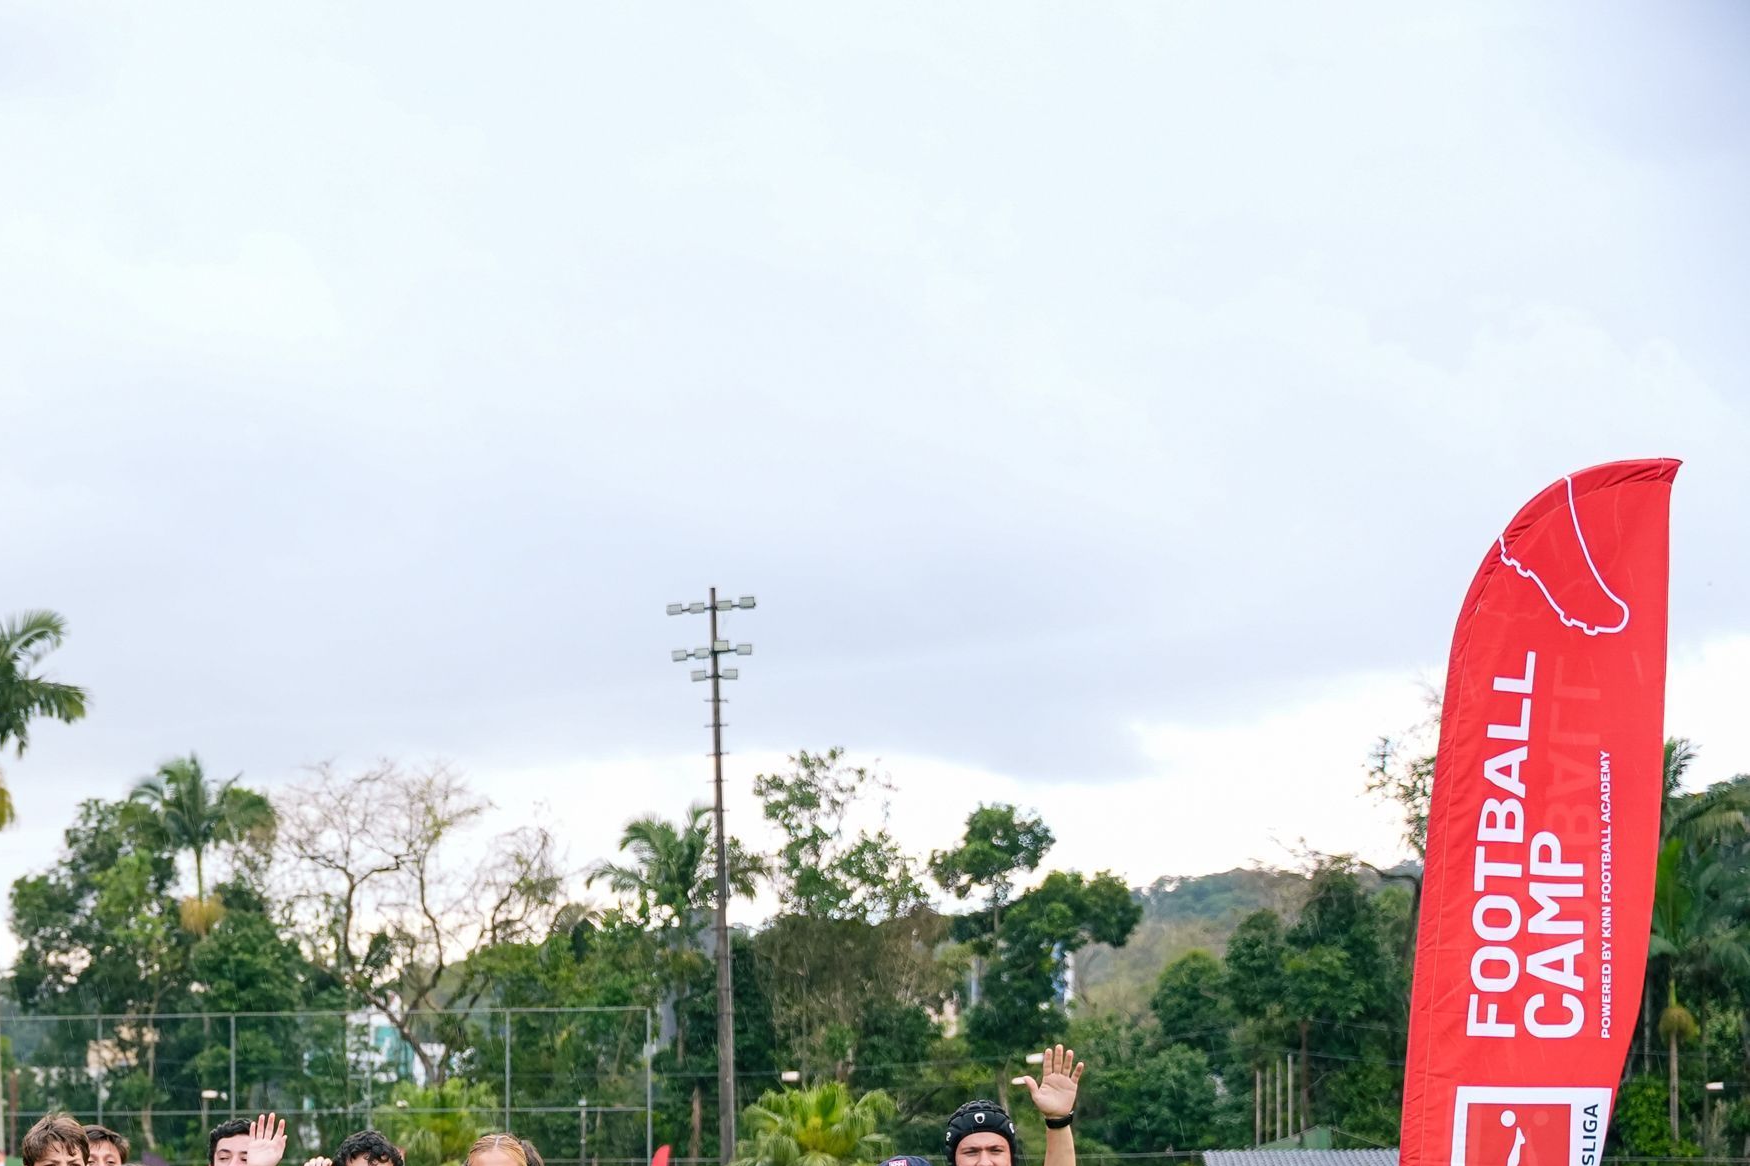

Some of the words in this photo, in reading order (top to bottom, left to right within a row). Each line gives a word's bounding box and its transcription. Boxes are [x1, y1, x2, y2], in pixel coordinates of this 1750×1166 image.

[1600, 750, 1611, 824] ACADEMY
[1466, 651, 1537, 1038] FOOTBALL
[1600, 825, 1611, 903] FOOTBALL
[1523, 831, 1585, 1039] CAMP
[1601, 905, 1611, 938] KNN
[1601, 940, 1611, 960] BY
[1601, 963, 1611, 1039] POWERED
